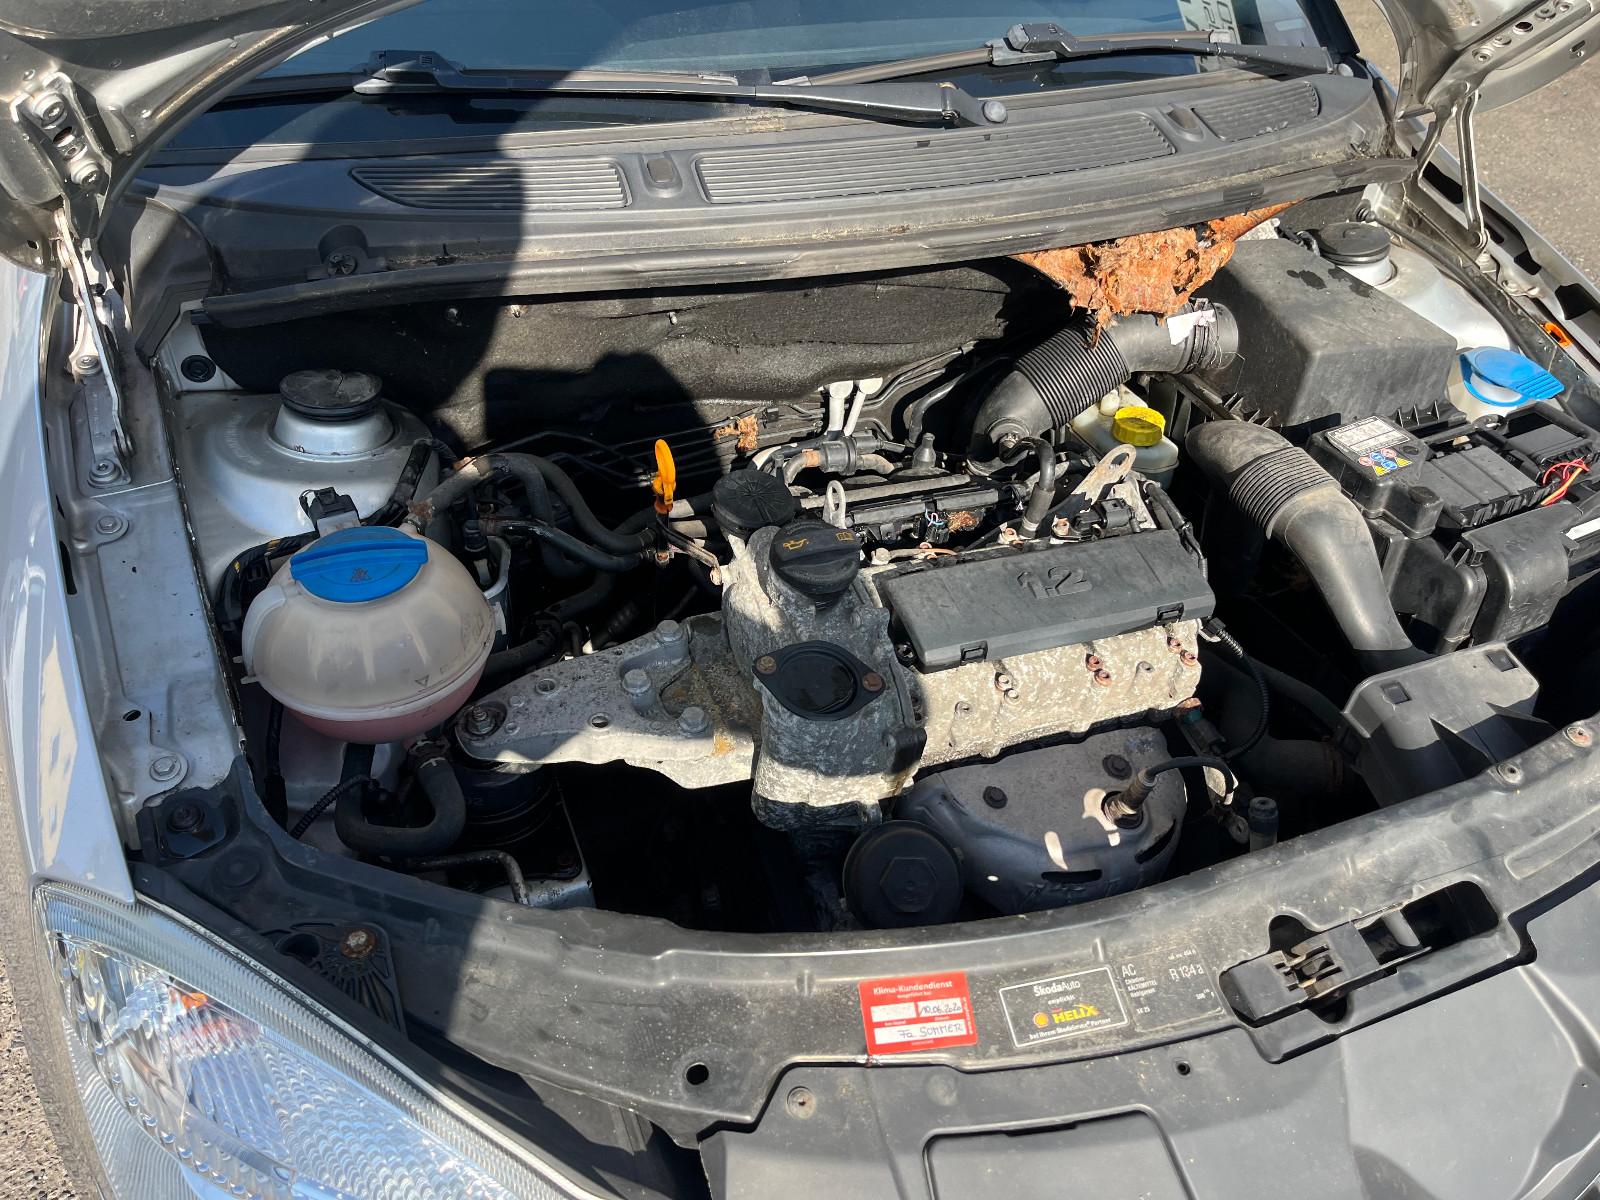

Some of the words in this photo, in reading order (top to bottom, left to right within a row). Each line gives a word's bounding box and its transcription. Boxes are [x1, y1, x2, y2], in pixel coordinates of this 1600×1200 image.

[1016, 565, 1093, 600] 1.2
[1121, 963, 1136, 977] AC
[873, 981, 953, 995] Klima-Kundendienst
[1052, 1004, 1099, 1023] HELIX
